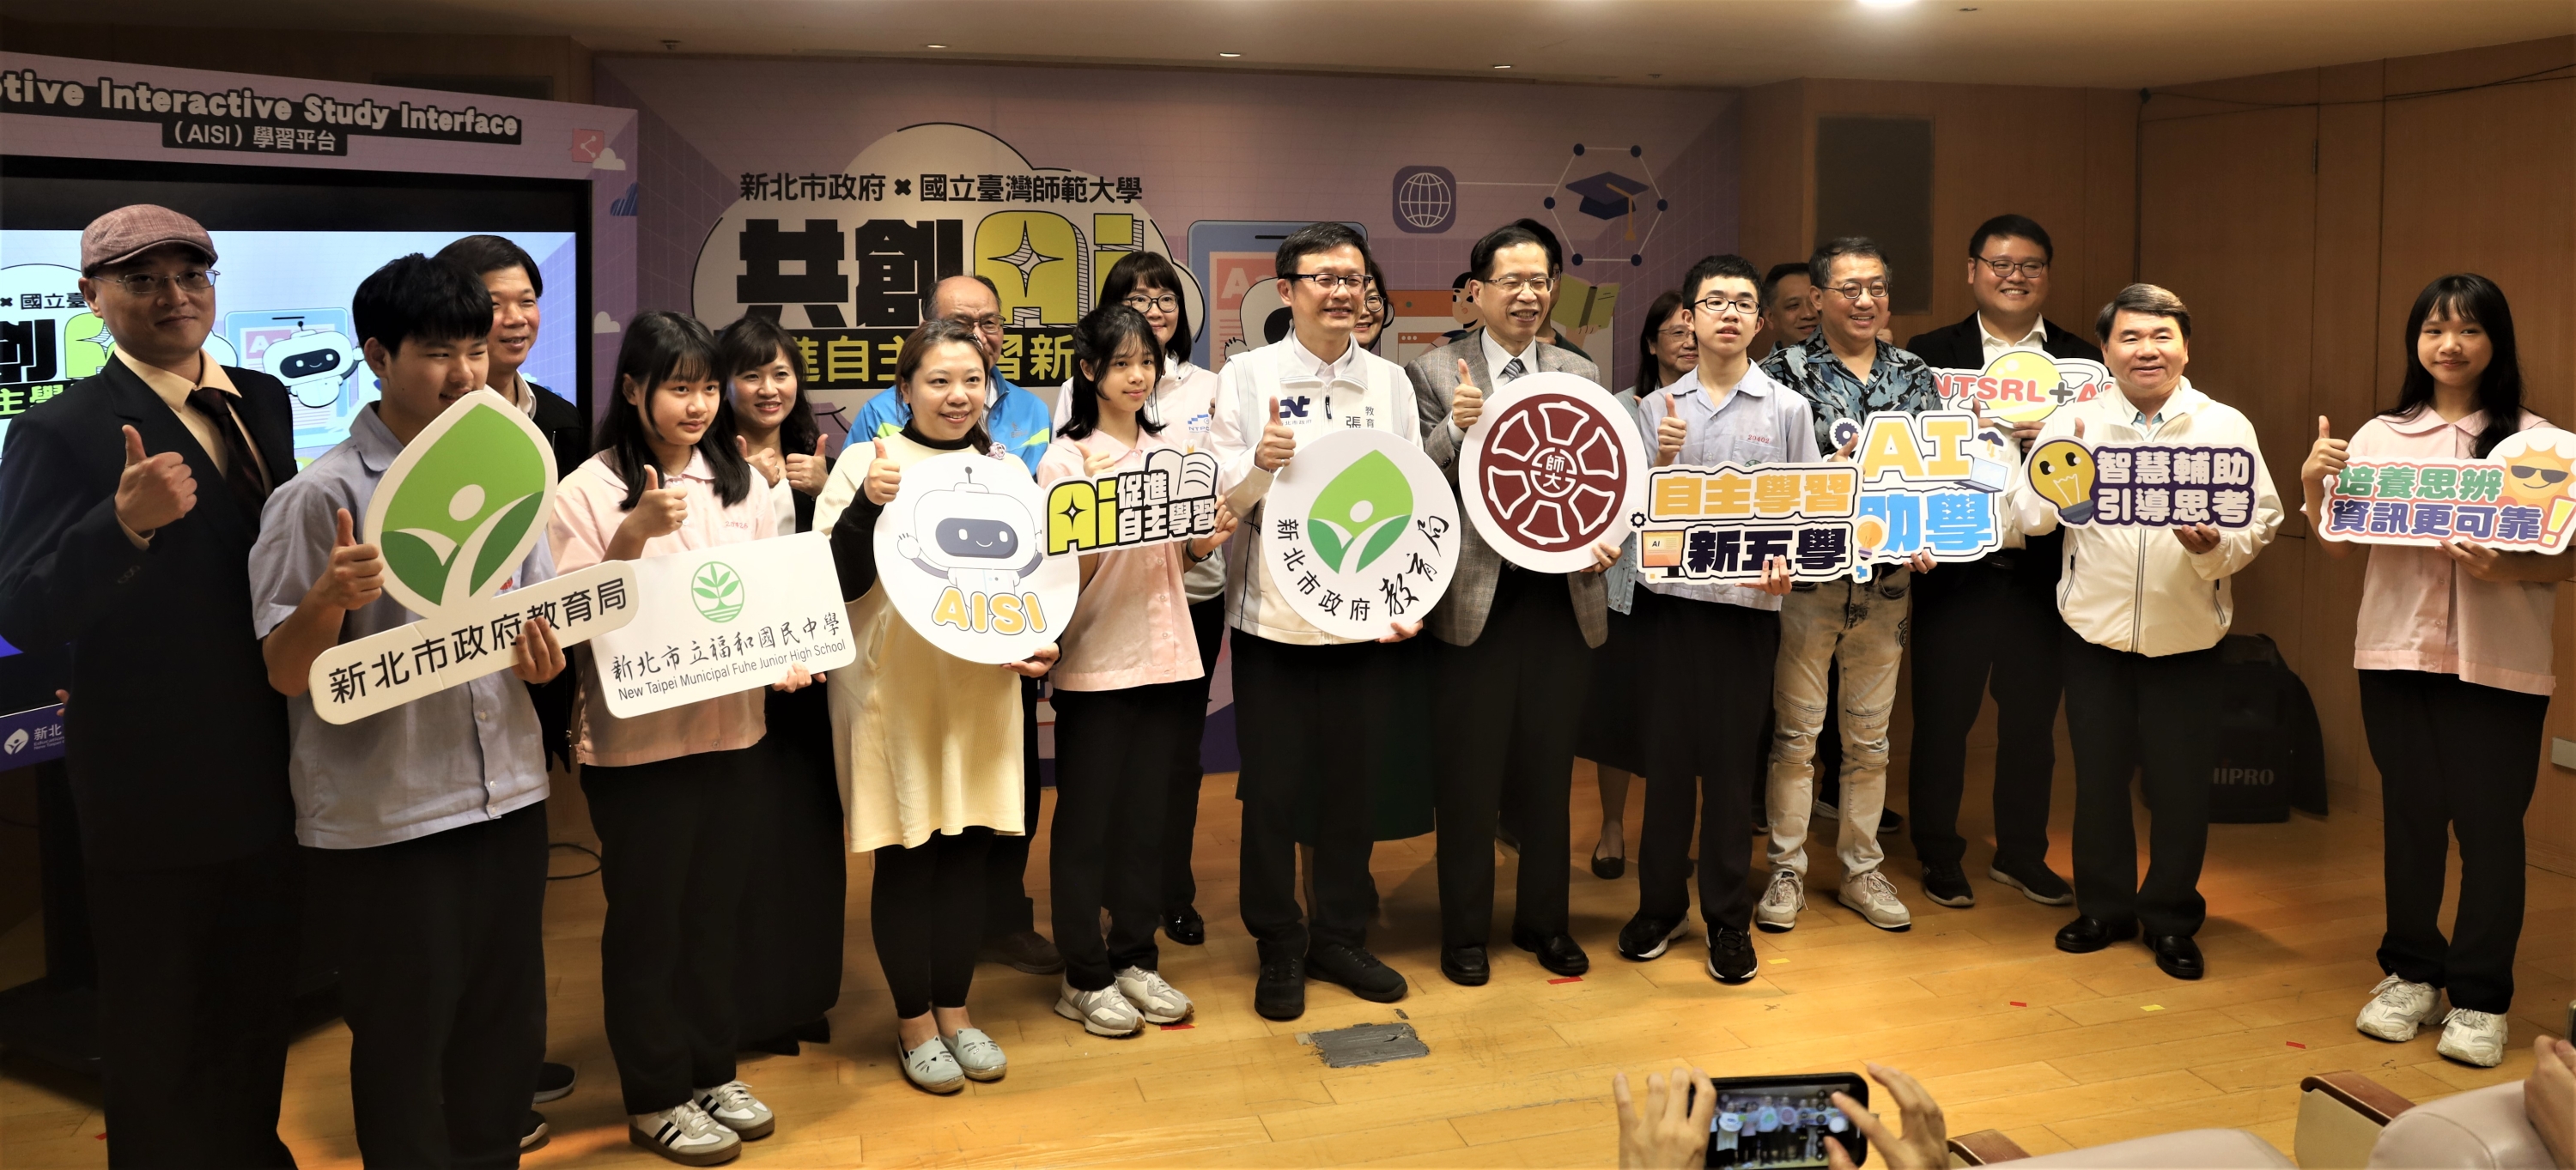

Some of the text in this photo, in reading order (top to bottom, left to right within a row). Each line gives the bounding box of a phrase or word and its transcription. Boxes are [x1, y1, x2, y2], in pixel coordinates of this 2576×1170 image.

[0, 72, 518, 136] tive Interactive Study Interface
[740, 172, 886, 202] 新北市政府
[920, 173, 1142, 203] 國立臺灣師範大學
[1934, 375, 2115, 403] NTSRL+A
[1747, 434, 1770, 444] 20402
[1862, 421, 1971, 477] AI
[1117, 471, 1169, 509] 促進
[1543, 454, 1565, 490] 師大
[2097, 451, 2250, 486] 智慧輔助
[2335, 465, 2503, 501] 培養思辨
[1655, 473, 1852, 516] 自主學習
[2097, 488, 2250, 524] 引導思考
[1119, 497, 1216, 544] 自主學習
[1277, 518, 1371, 621] 新北市政府
[1687, 528, 1846, 573] 新五學
[932, 585, 1048, 636] AISI
[329, 578, 627, 704] 新北市政府教育局
[611, 612, 840, 682] 新北市立福和國民中學
[618, 639, 847, 701] New Taipei Municipal Fuhe Junior High School
